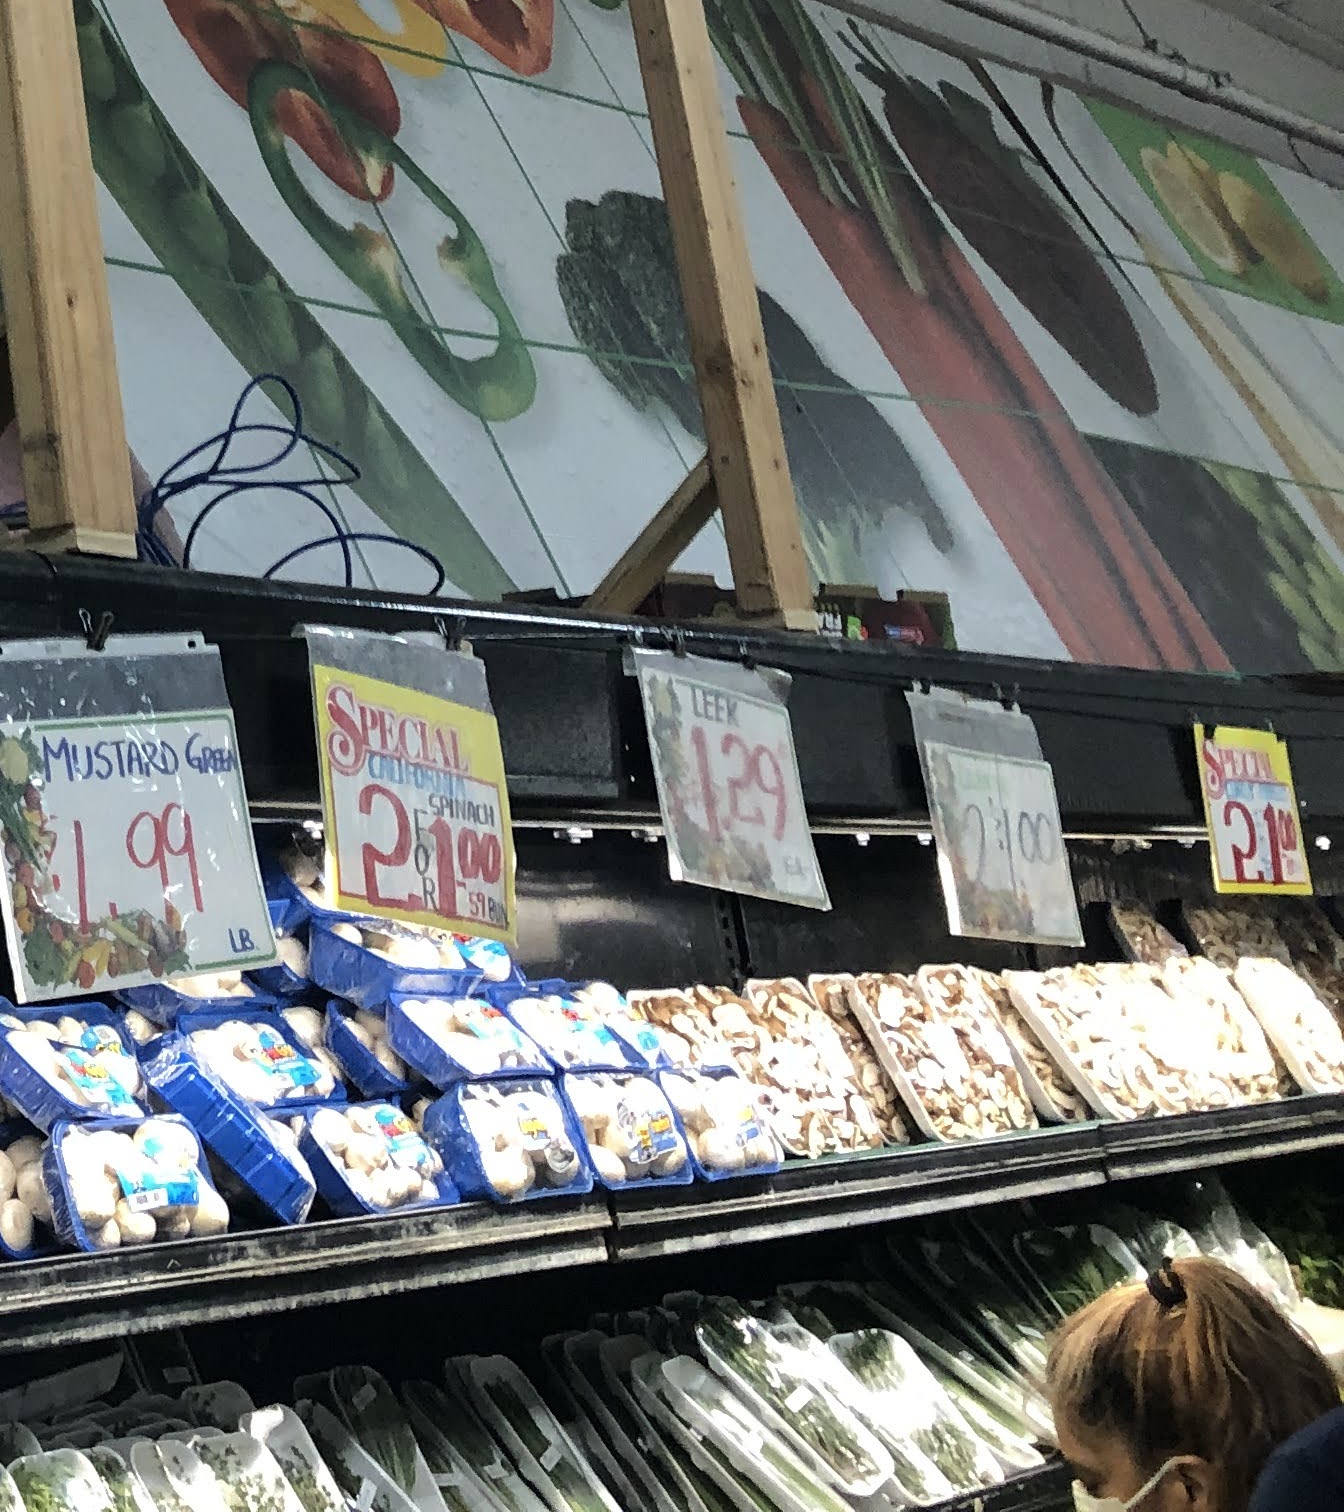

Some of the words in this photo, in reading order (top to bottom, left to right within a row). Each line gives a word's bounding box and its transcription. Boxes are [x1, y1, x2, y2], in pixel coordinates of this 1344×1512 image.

[327, 685, 469, 775] SPECIAL
[691, 686, 740, 728] LEEK
[42, 734, 179, 783] MUSTARD
[429, 792, 496, 828] SPINACH
[1223, 800, 1265, 884] 2
[358, 783, 423, 912] 2
